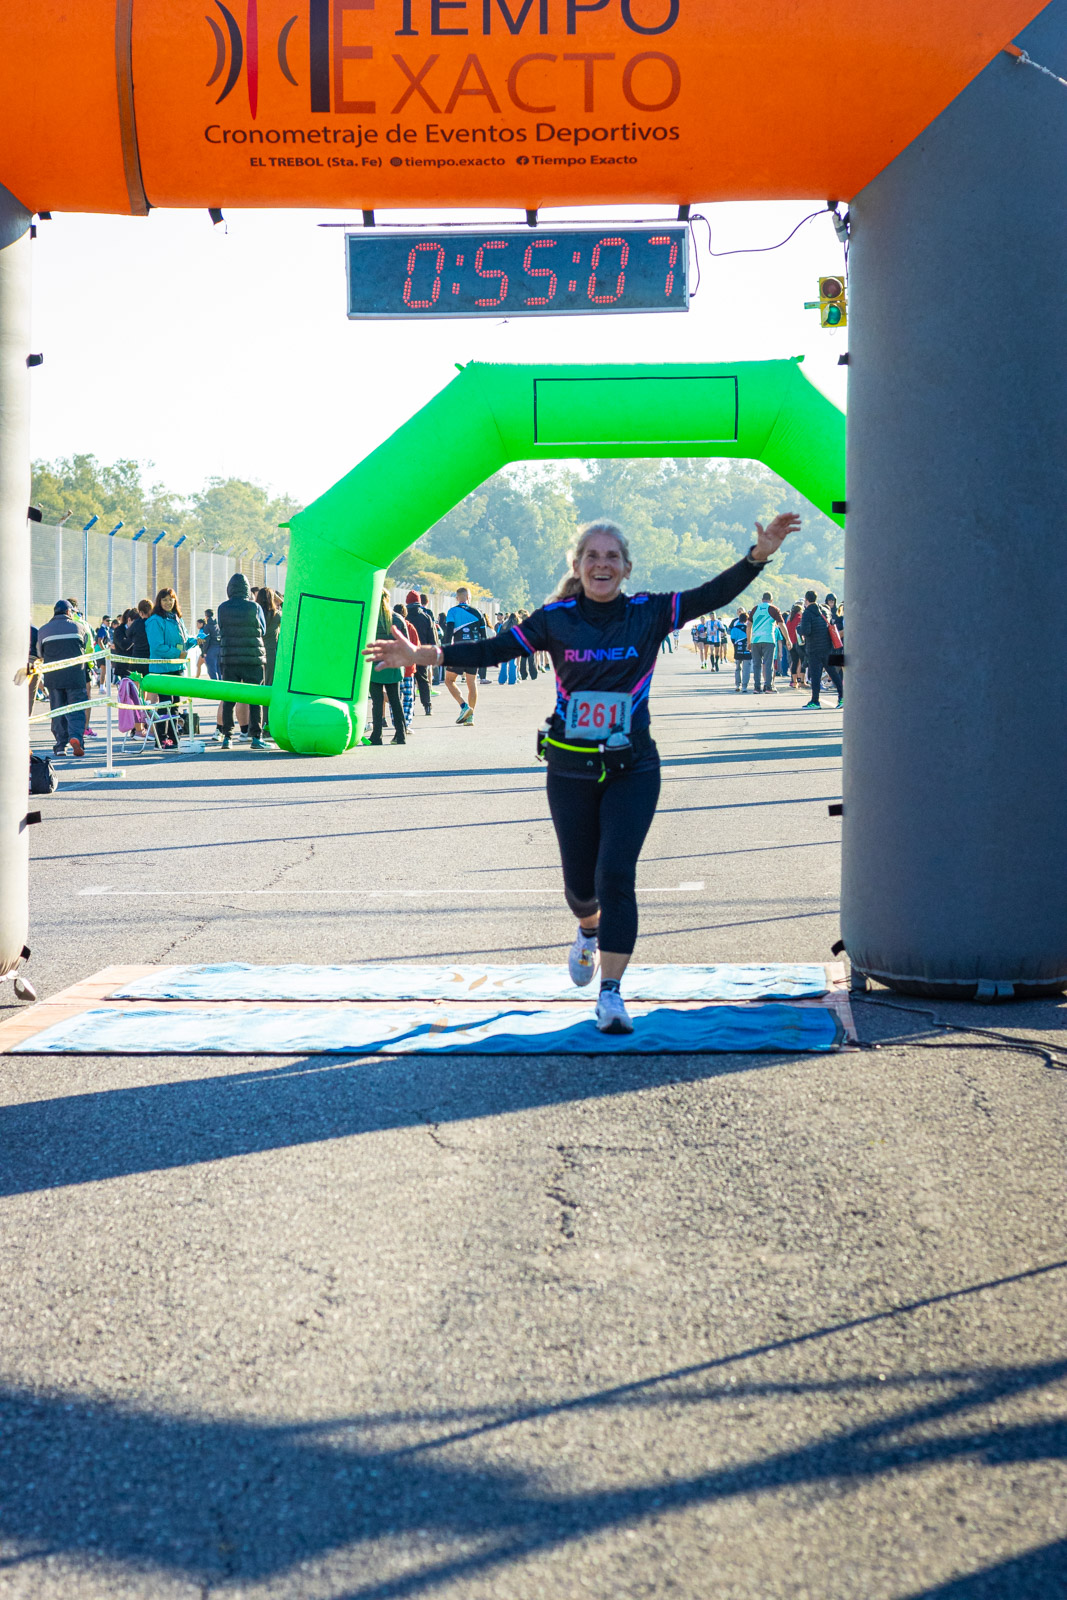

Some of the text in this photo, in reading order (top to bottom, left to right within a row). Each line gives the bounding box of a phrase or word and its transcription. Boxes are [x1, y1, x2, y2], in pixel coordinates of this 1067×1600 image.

[204, 122, 680, 148] Cronometraje de Eventos Deportivos
[250, 154, 638, 169] EL TREBOL (Sta. Fe) tiempo.exacto Tiempo Exacto
[402, 237, 679, 308] 0:55:07
[564, 645, 639, 662] RUNNEA
[578, 702, 618, 729] 261
